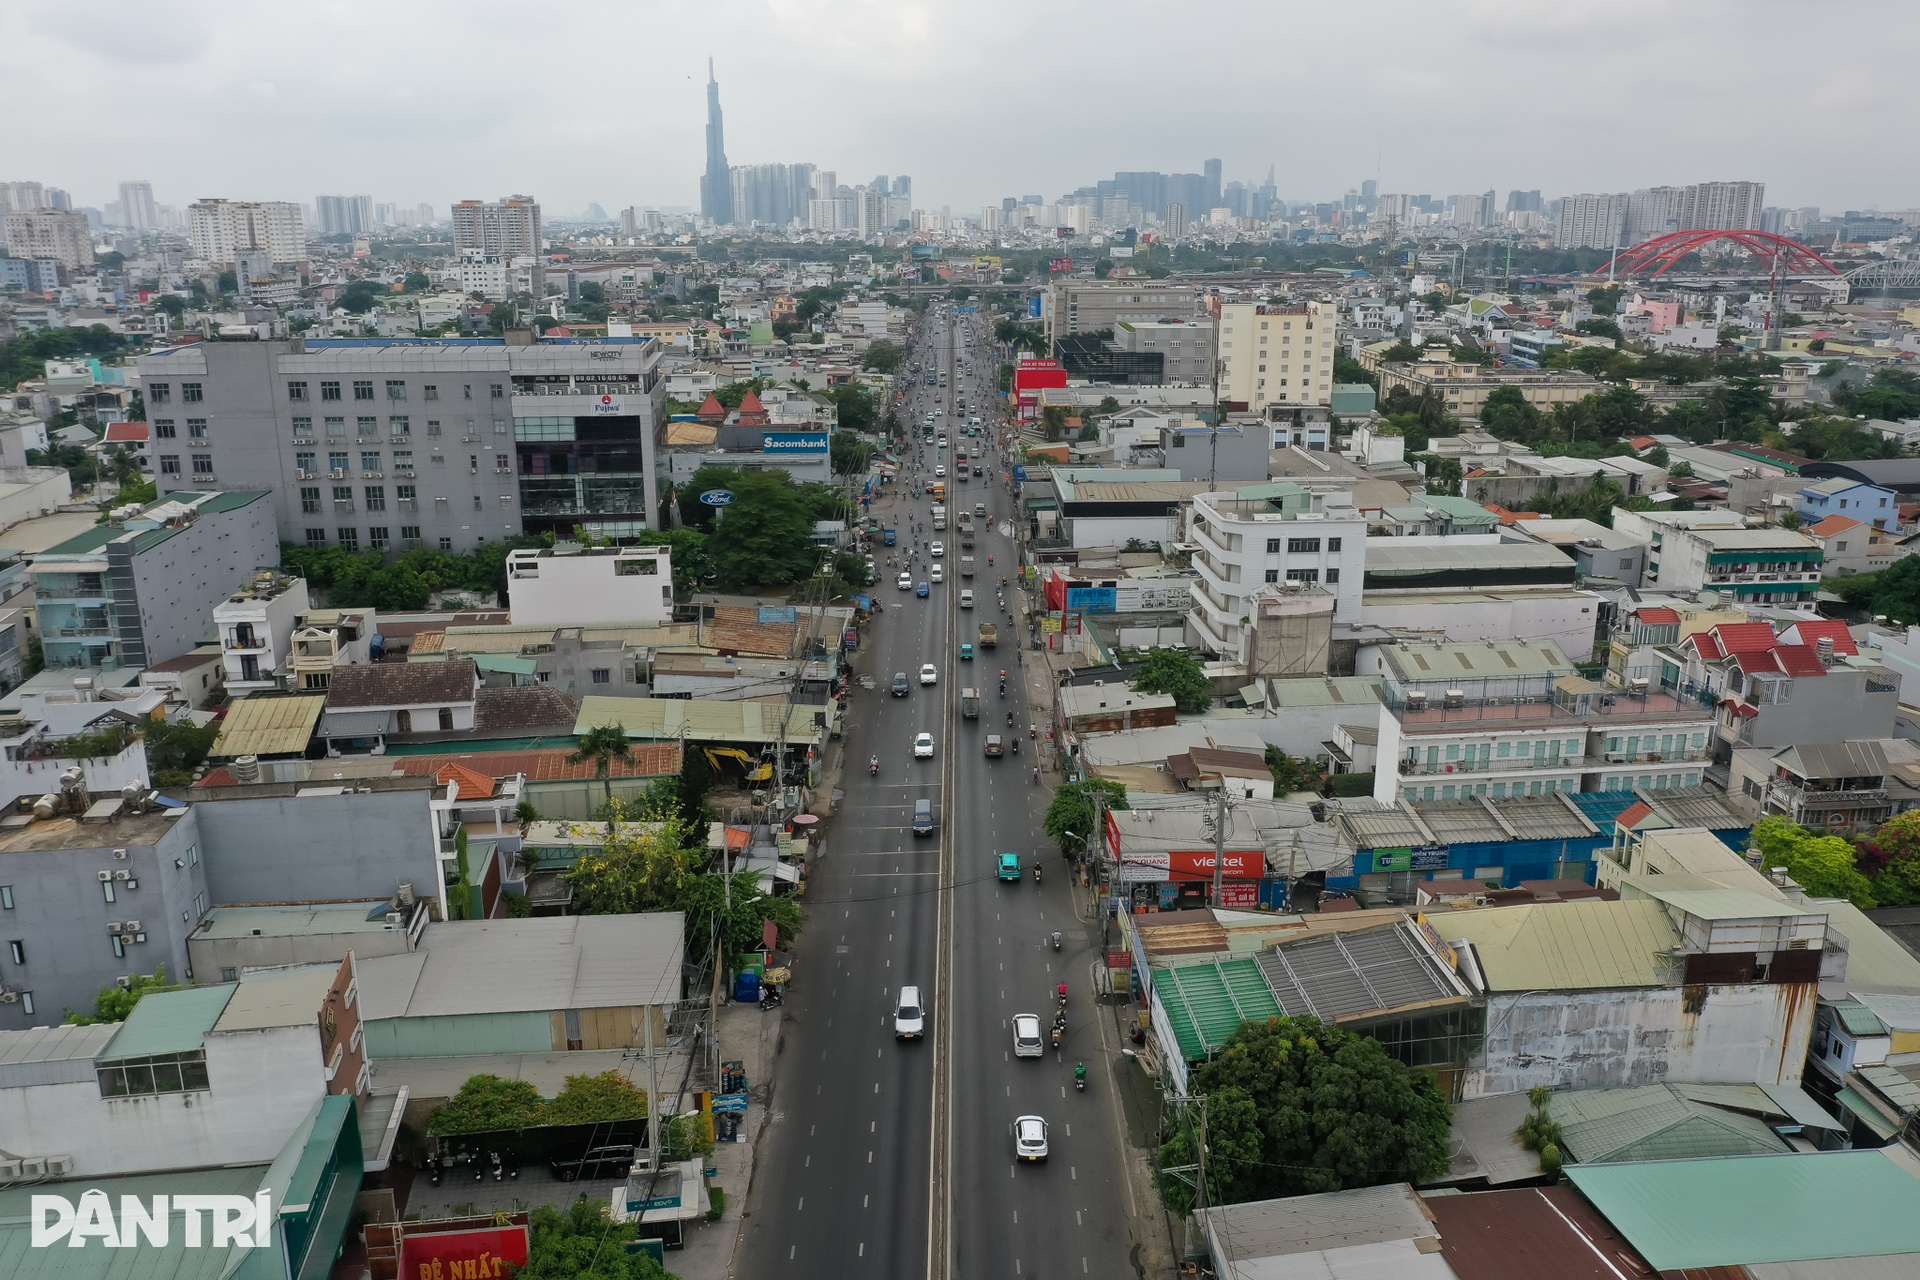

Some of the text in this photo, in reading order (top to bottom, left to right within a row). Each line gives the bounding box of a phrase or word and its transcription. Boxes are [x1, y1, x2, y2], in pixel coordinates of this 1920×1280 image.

[764, 437, 826, 448] Sacombank
[707, 493, 731, 503] Ford
[1193, 857, 1244, 867] vietel
[1381, 857, 1408, 865] TUBORG
[449, 1252, 502, 1280] NHẤT
